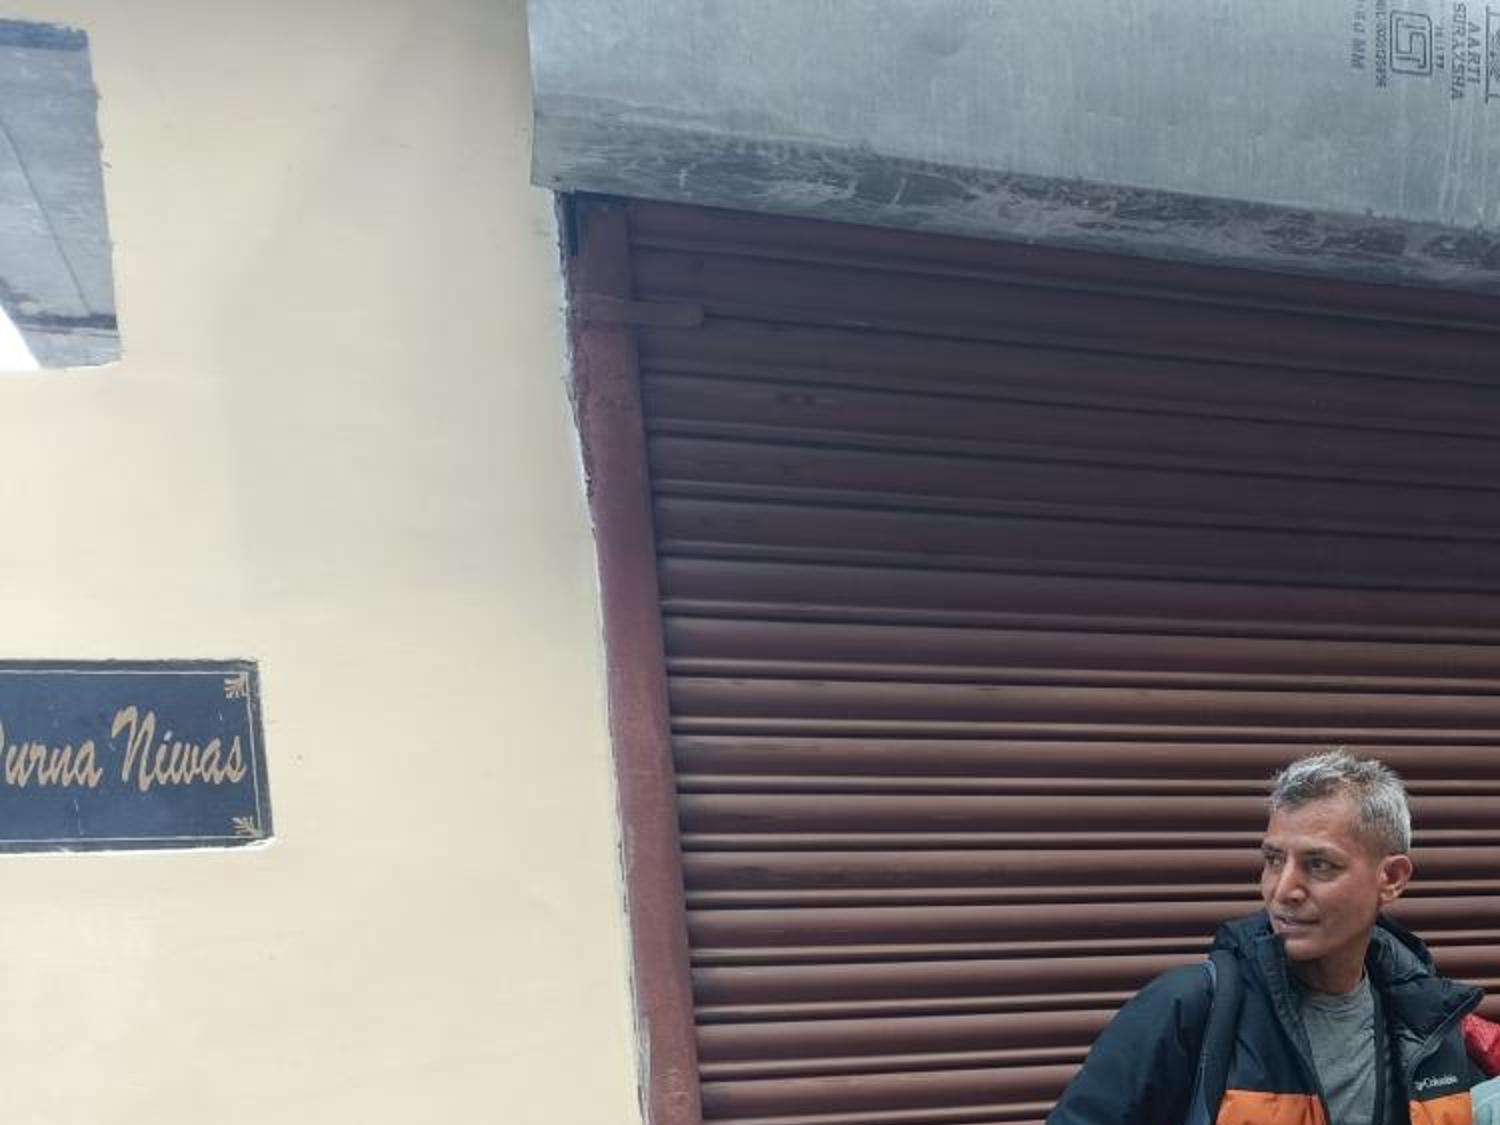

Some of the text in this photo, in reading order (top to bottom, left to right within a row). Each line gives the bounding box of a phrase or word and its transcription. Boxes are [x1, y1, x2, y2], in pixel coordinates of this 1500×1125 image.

[1467, 20, 1481, 84] AARTI
[0, 704, 248, 793] urna Niwas
